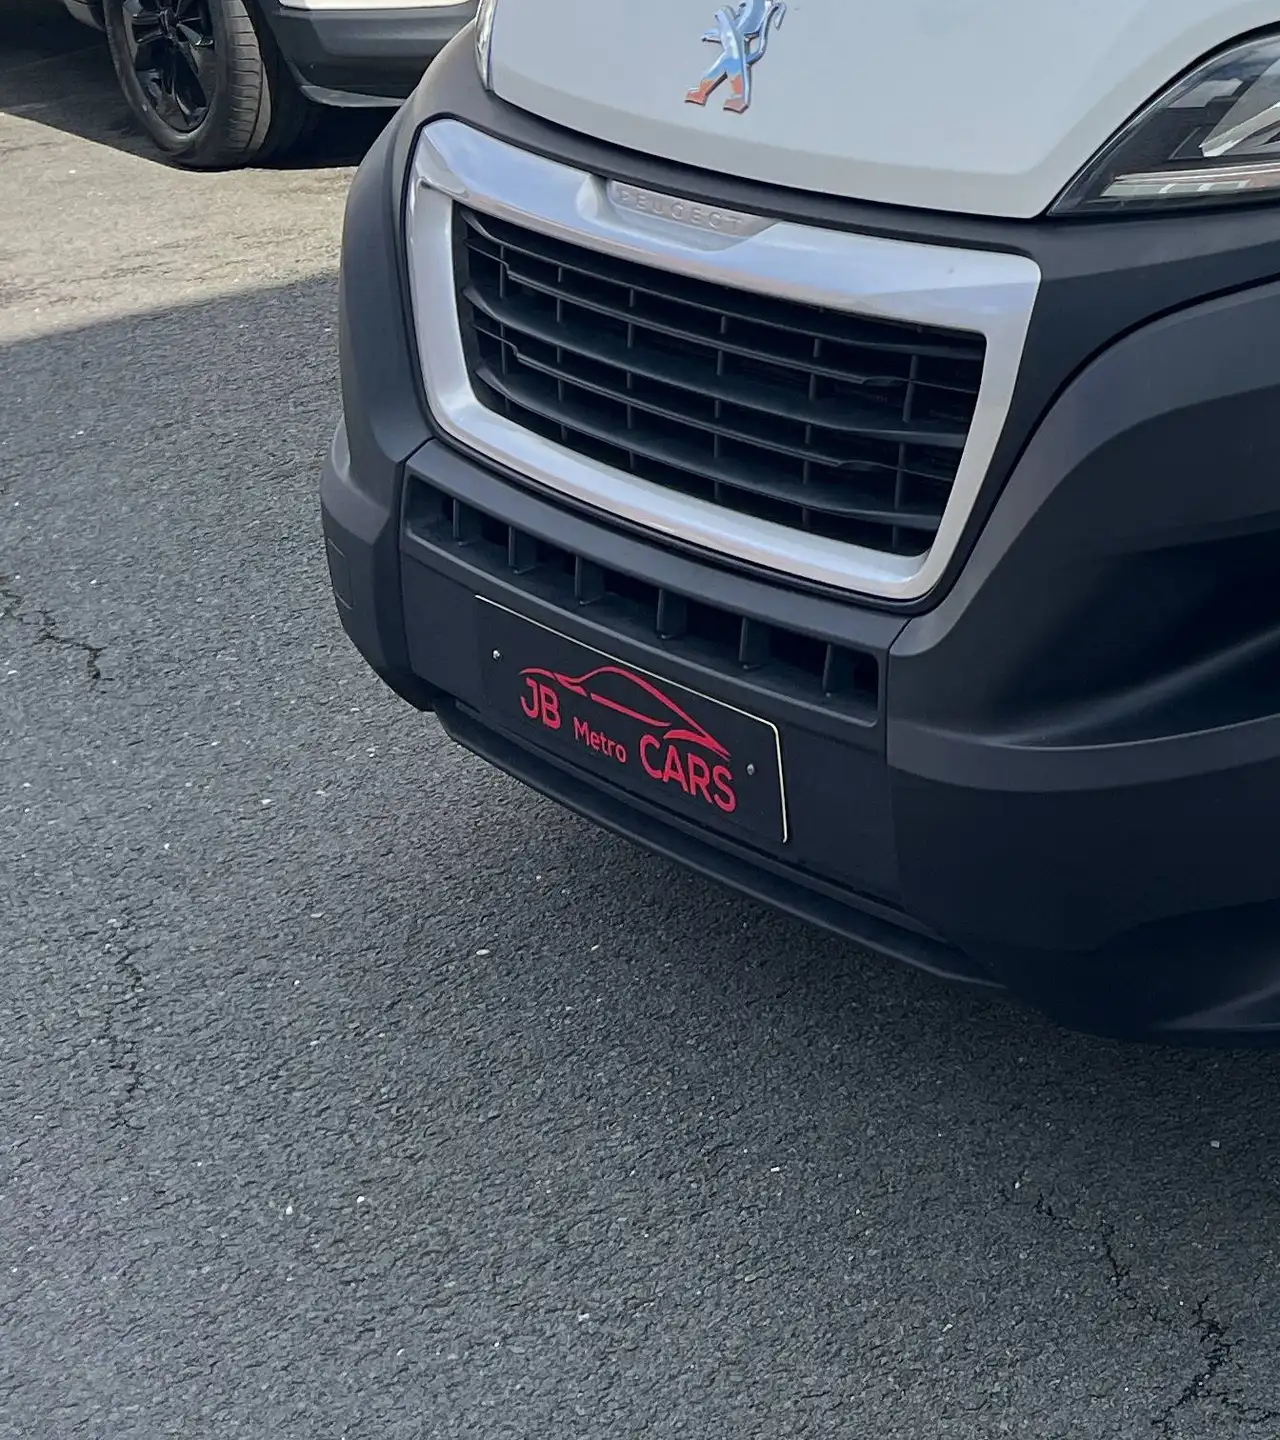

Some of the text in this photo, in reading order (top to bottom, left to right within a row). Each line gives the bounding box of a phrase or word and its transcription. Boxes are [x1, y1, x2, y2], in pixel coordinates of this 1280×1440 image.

[618, 190, 745, 235] PEUGEOT
[520, 677, 737, 812] JB Metro CARS
